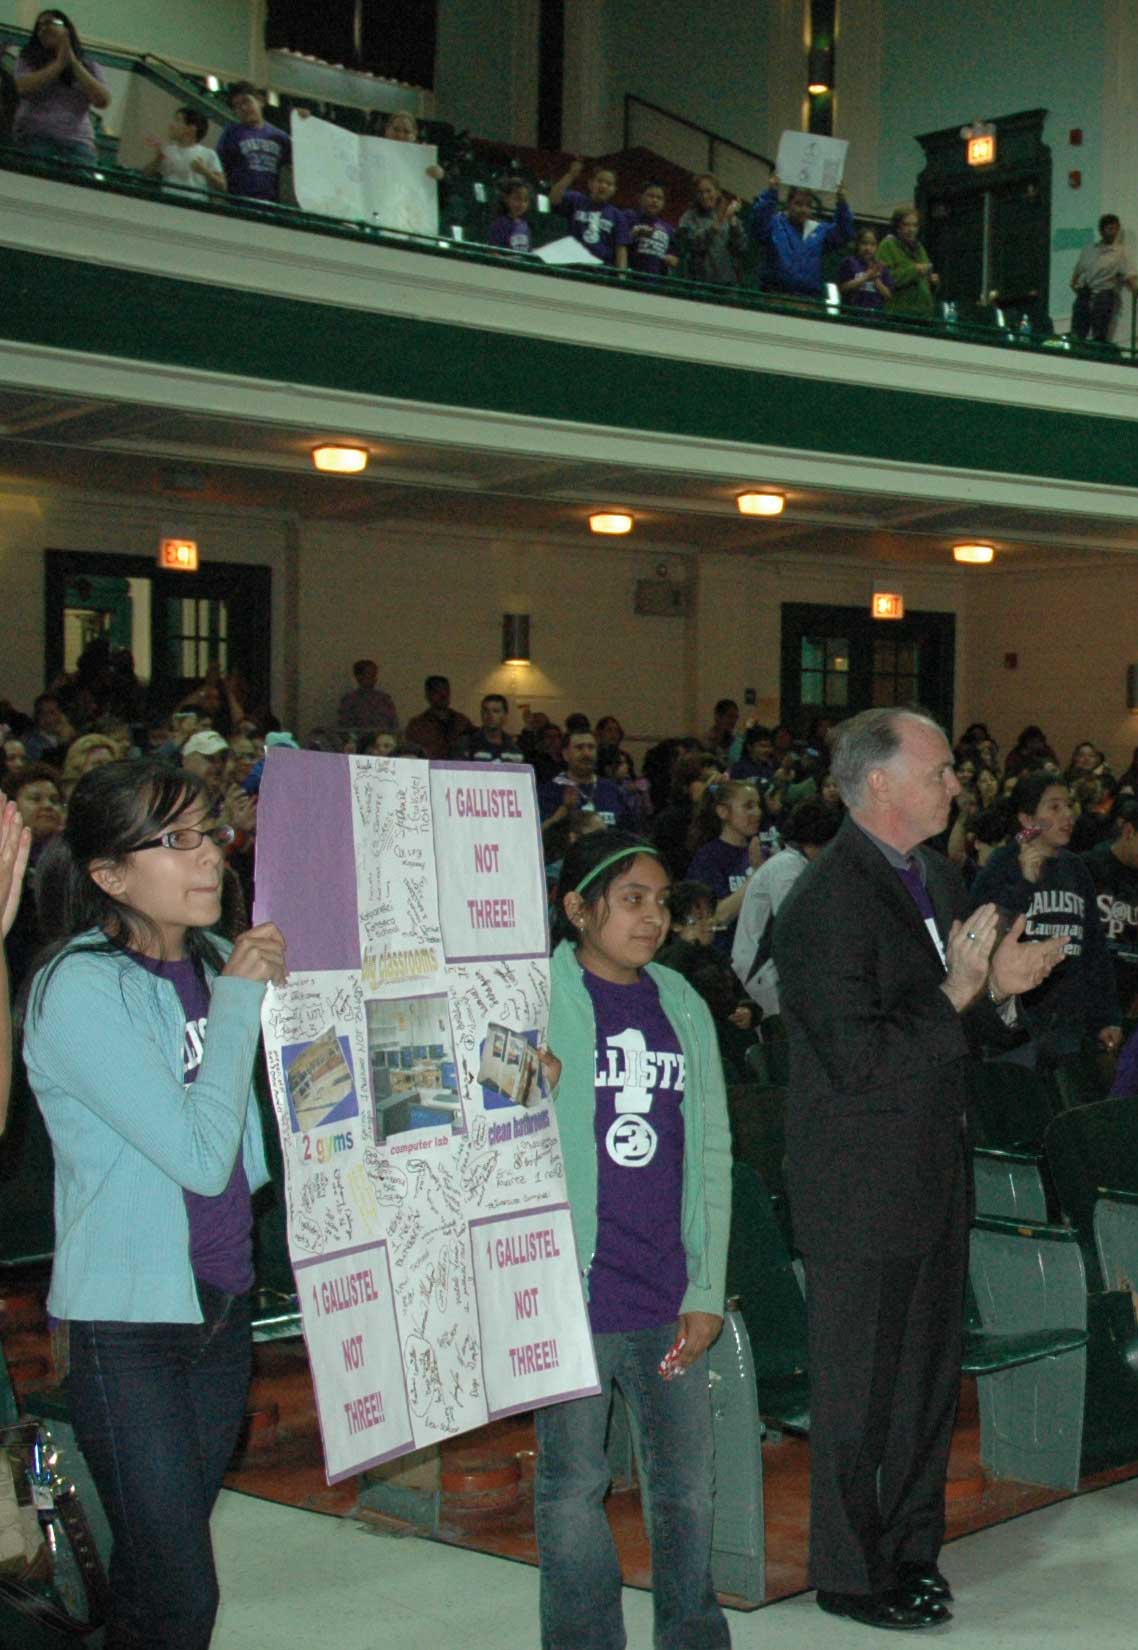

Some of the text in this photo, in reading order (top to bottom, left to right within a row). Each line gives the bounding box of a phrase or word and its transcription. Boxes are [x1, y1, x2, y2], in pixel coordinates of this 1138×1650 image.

[445, 787, 522, 818] 1 GALLISTEL
[474, 843, 499, 873] NOT
[467, 899, 516, 929] THREE!!
[302, 1130, 354, 1164] 2 gyms
[391, 1135, 449, 1156] computer lab
[488, 1121, 512, 1145] clean
[486, 1229, 560, 1270] 1 GALLISTEL
[313, 1285, 320, 1317] 1
[321, 1269, 379, 1315] GALLISTEL
[514, 1287, 539, 1320] NOT
[342, 1334, 364, 1373] NOT
[509, 1339, 560, 1378] THREE!!
[344, 1391, 386, 1435] THREE!!
